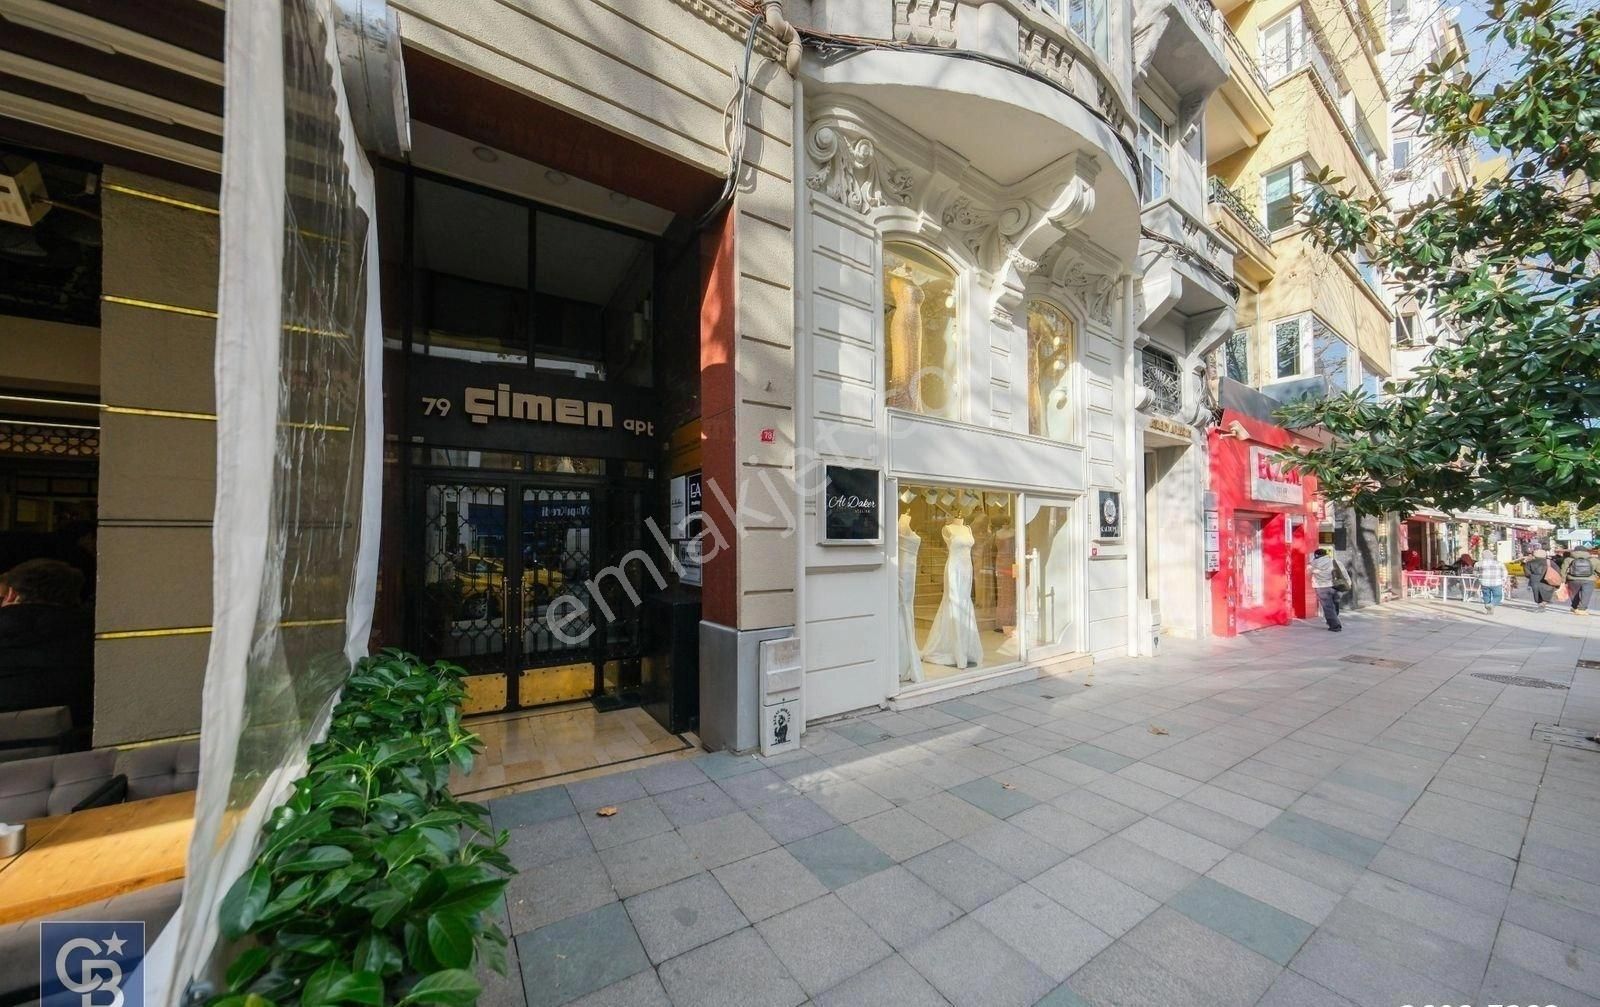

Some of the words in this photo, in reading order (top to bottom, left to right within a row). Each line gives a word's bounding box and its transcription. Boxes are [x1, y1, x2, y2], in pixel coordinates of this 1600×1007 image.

[422, 397, 451, 417] 79
[623, 418, 654, 437] apt
[828, 494, 847, 509] Al
[847, 495, 877, 508] Daker
[1226, 517, 1235, 629] ECZANE
